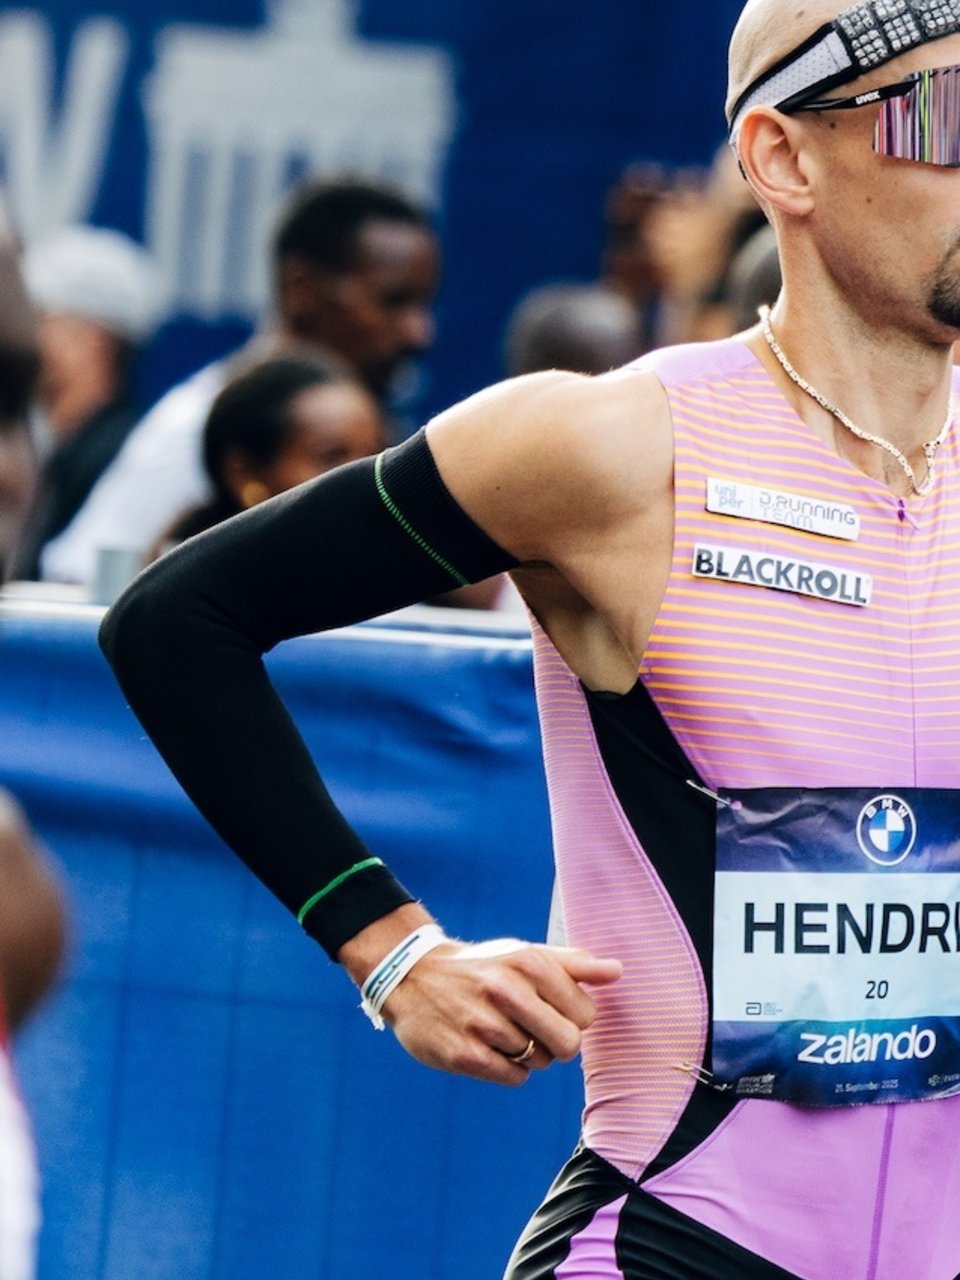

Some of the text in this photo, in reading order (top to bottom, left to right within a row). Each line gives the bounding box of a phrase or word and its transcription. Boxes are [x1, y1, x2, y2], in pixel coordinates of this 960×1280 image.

[855, 90, 881, 105] uvex
[713, 483, 737, 500] uni
[718, 494, 745, 510] per
[694, 548, 868, 604] BLACKROLL
[865, 798, 909, 819] BMW
[865, 980, 889, 1000] 20
[798, 1025, 937, 1065] zalando
